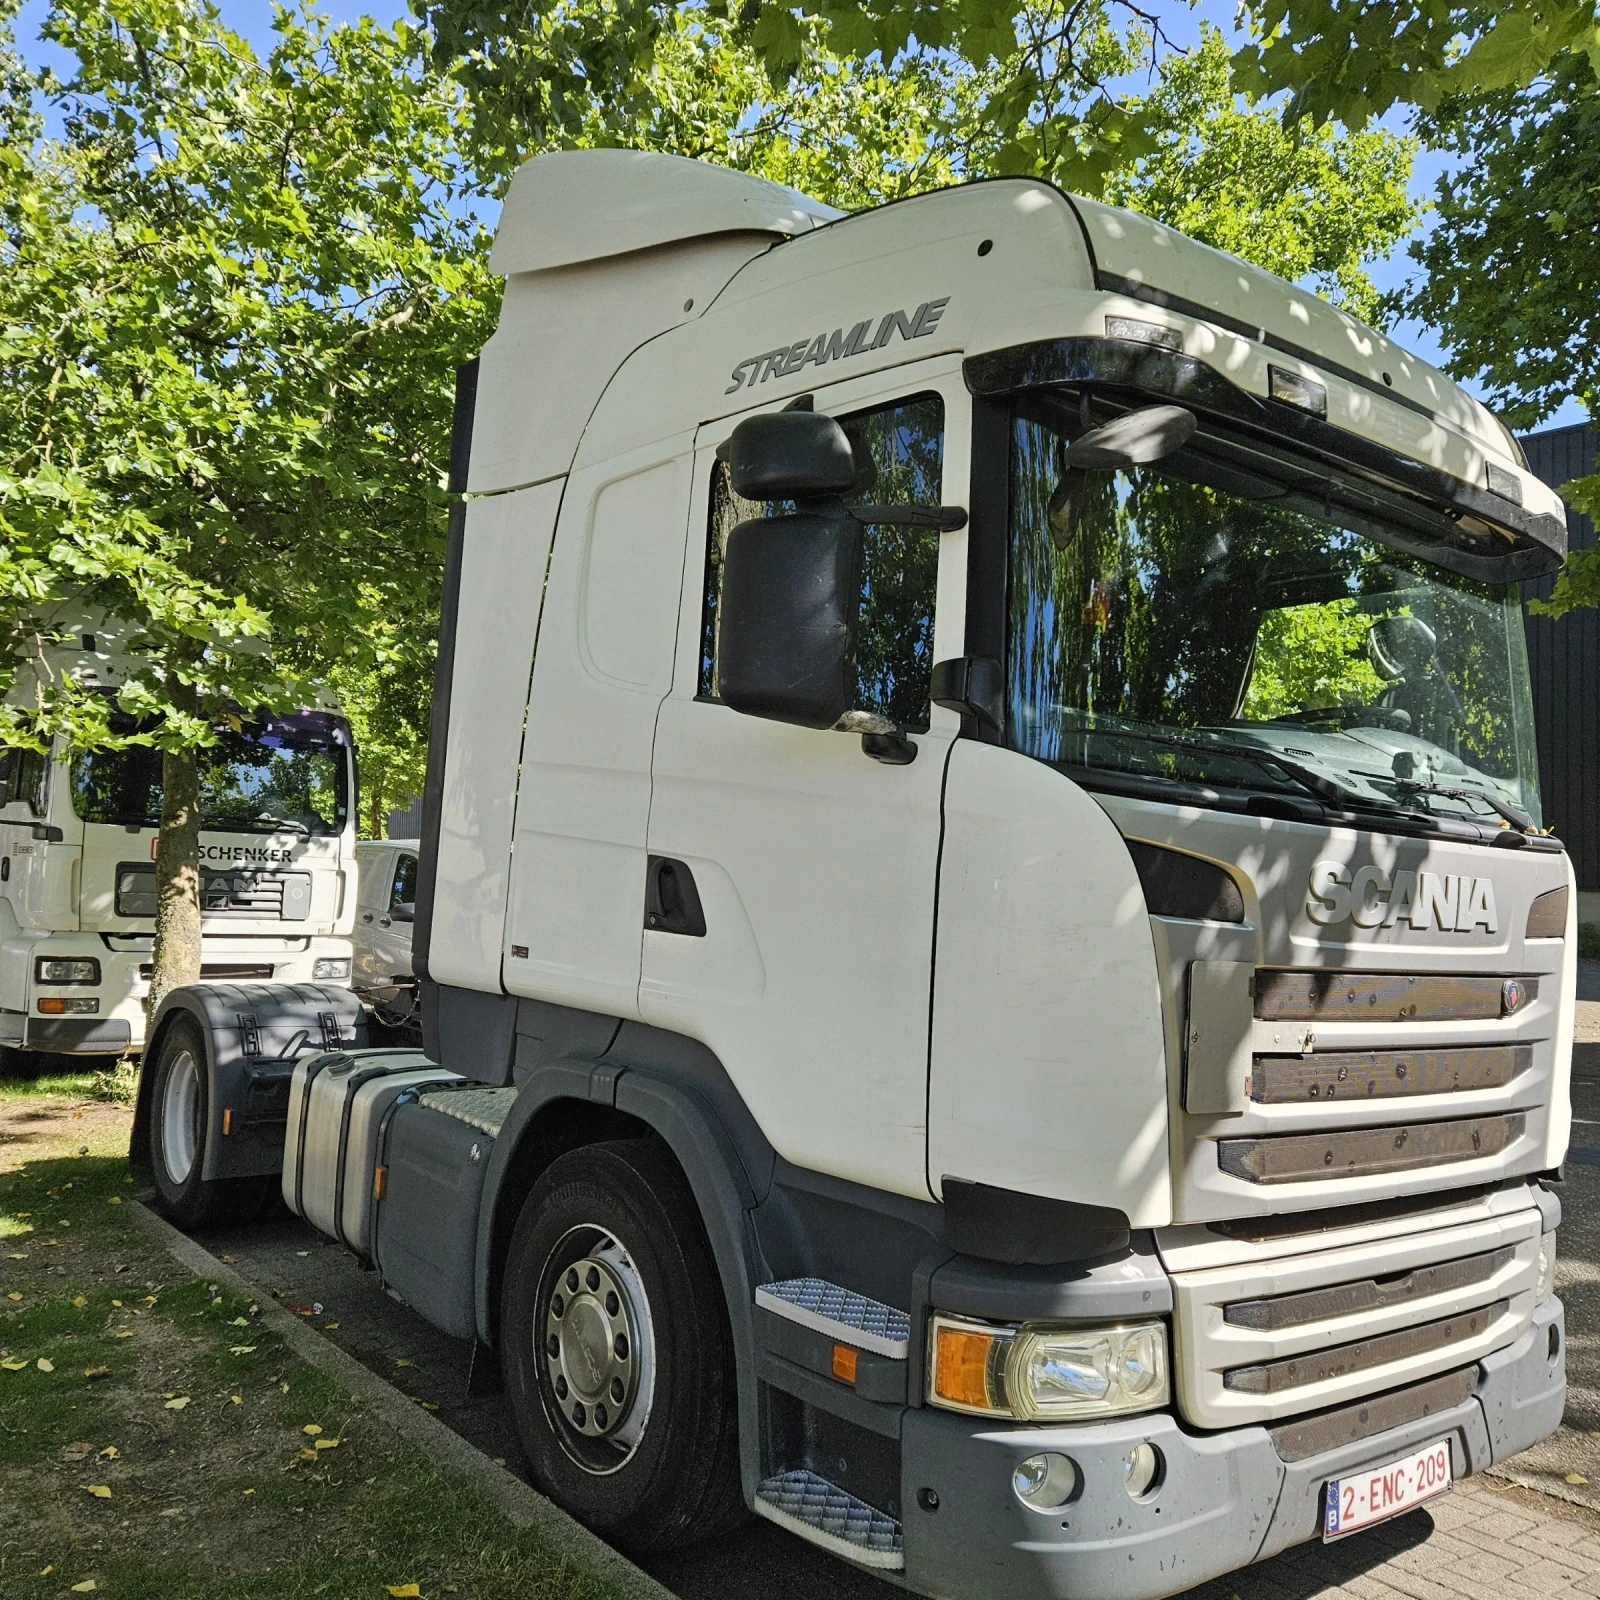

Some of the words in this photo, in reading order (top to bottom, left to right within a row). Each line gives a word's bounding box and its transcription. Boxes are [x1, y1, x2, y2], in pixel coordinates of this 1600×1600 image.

[725, 296, 952, 395] STREAMLINE
[200, 877, 254, 892] AN
[1306, 860, 1498, 934] SCANIA
[1328, 1510, 1338, 1527] B
